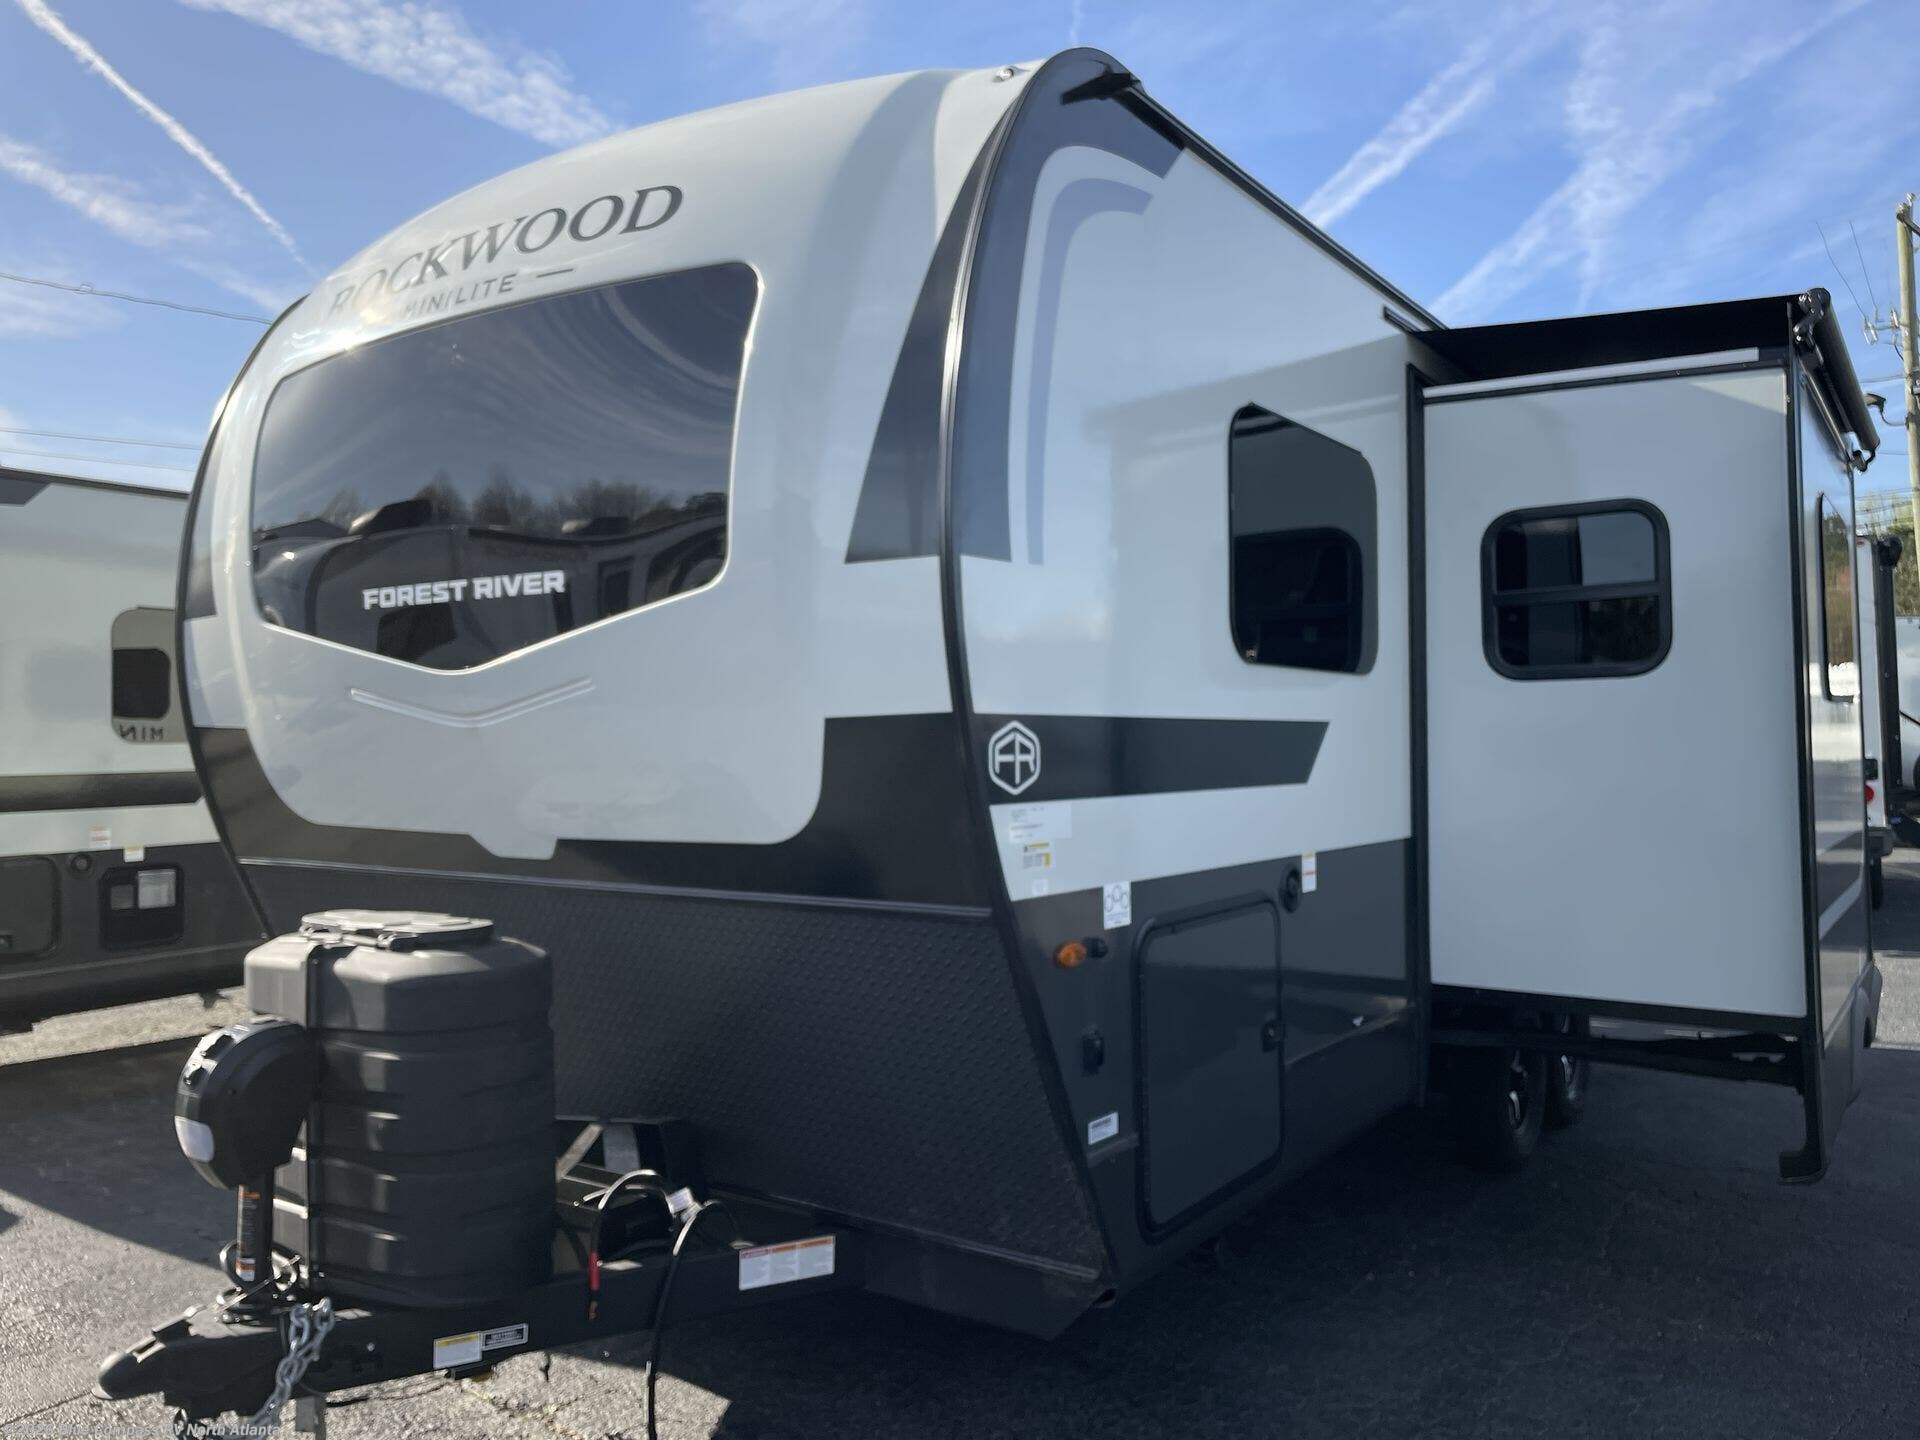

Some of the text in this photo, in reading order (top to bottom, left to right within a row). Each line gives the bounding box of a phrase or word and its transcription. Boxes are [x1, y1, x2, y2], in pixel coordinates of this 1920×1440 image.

[327, 184, 684, 319] ROCKWOOD
[362, 569, 565, 611] FOREST RIVER
